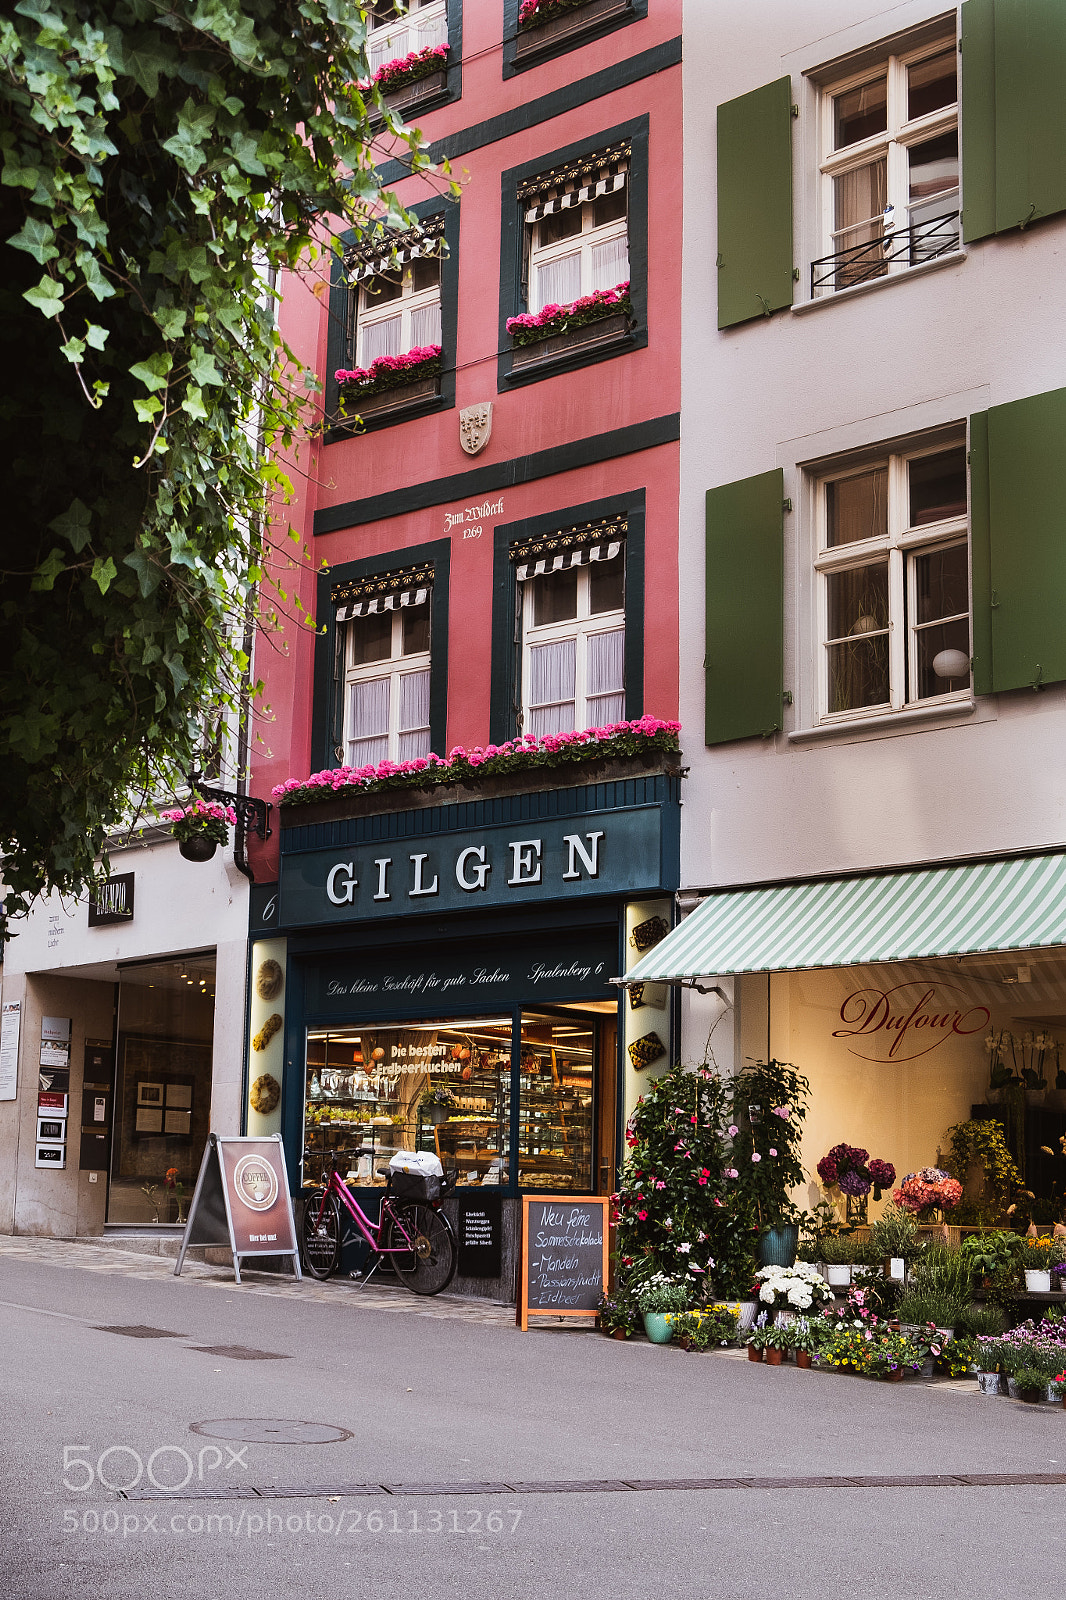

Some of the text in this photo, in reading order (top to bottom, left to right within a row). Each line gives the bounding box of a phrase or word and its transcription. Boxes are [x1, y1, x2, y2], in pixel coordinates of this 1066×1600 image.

[443, 512, 464, 533] Zum
[462, 525, 483, 540] 1269
[325, 830, 605, 906] GILGEN
[262, 893, 278, 921] 6
[326, 960, 605, 996] Das kleine Geschäft für gute Sachen Spalenberg 6
[831, 981, 991, 1062] Dufour
[391, 1044, 447, 1058] Die besten
[376, 1060, 461, 1076] Erdbeerkuchen
[540, 1206, 591, 1234] Neu feine
